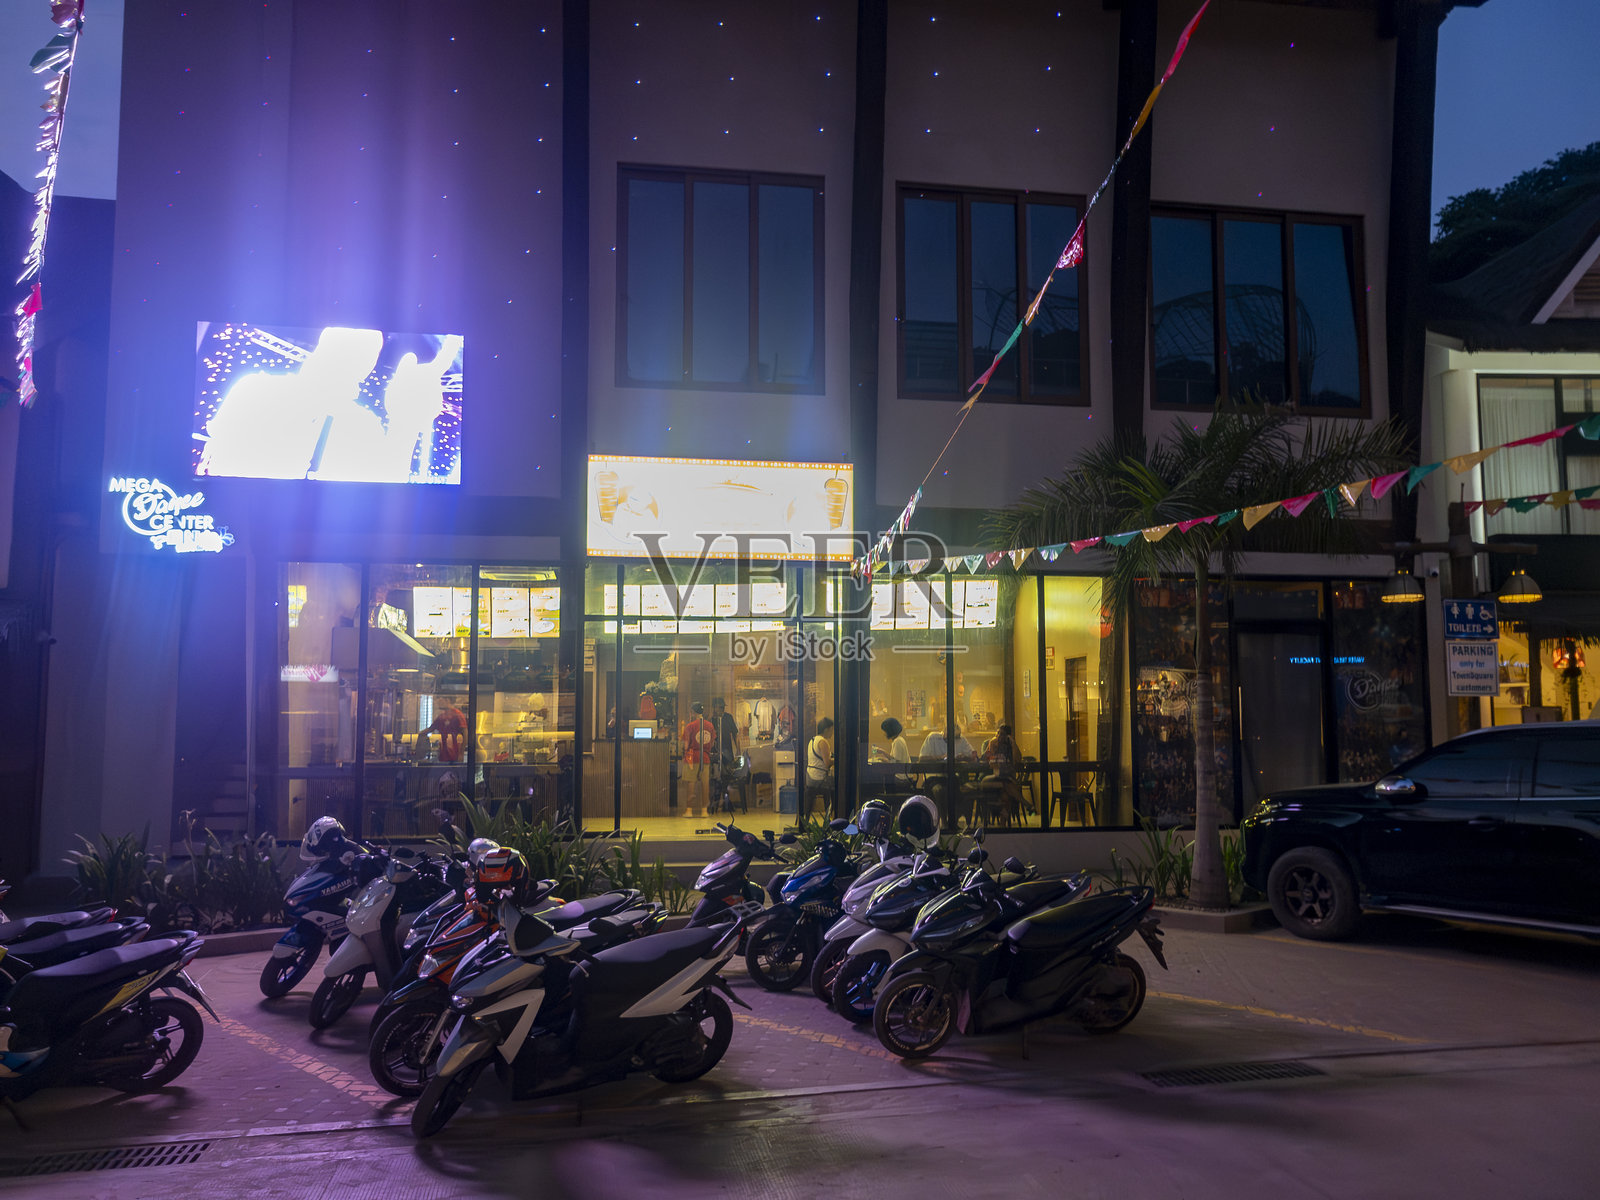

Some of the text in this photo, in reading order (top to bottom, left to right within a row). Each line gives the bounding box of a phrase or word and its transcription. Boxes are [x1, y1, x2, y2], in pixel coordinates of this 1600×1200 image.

[109, 478, 162, 492] MEGA
[133, 492, 205, 521] Dance
[150, 515, 214, 530] CENTER
[1448, 623, 1482, 633] TOILETS
[1452, 646, 1494, 656] PARKING
[321, 879, 352, 896] YAMAHA
